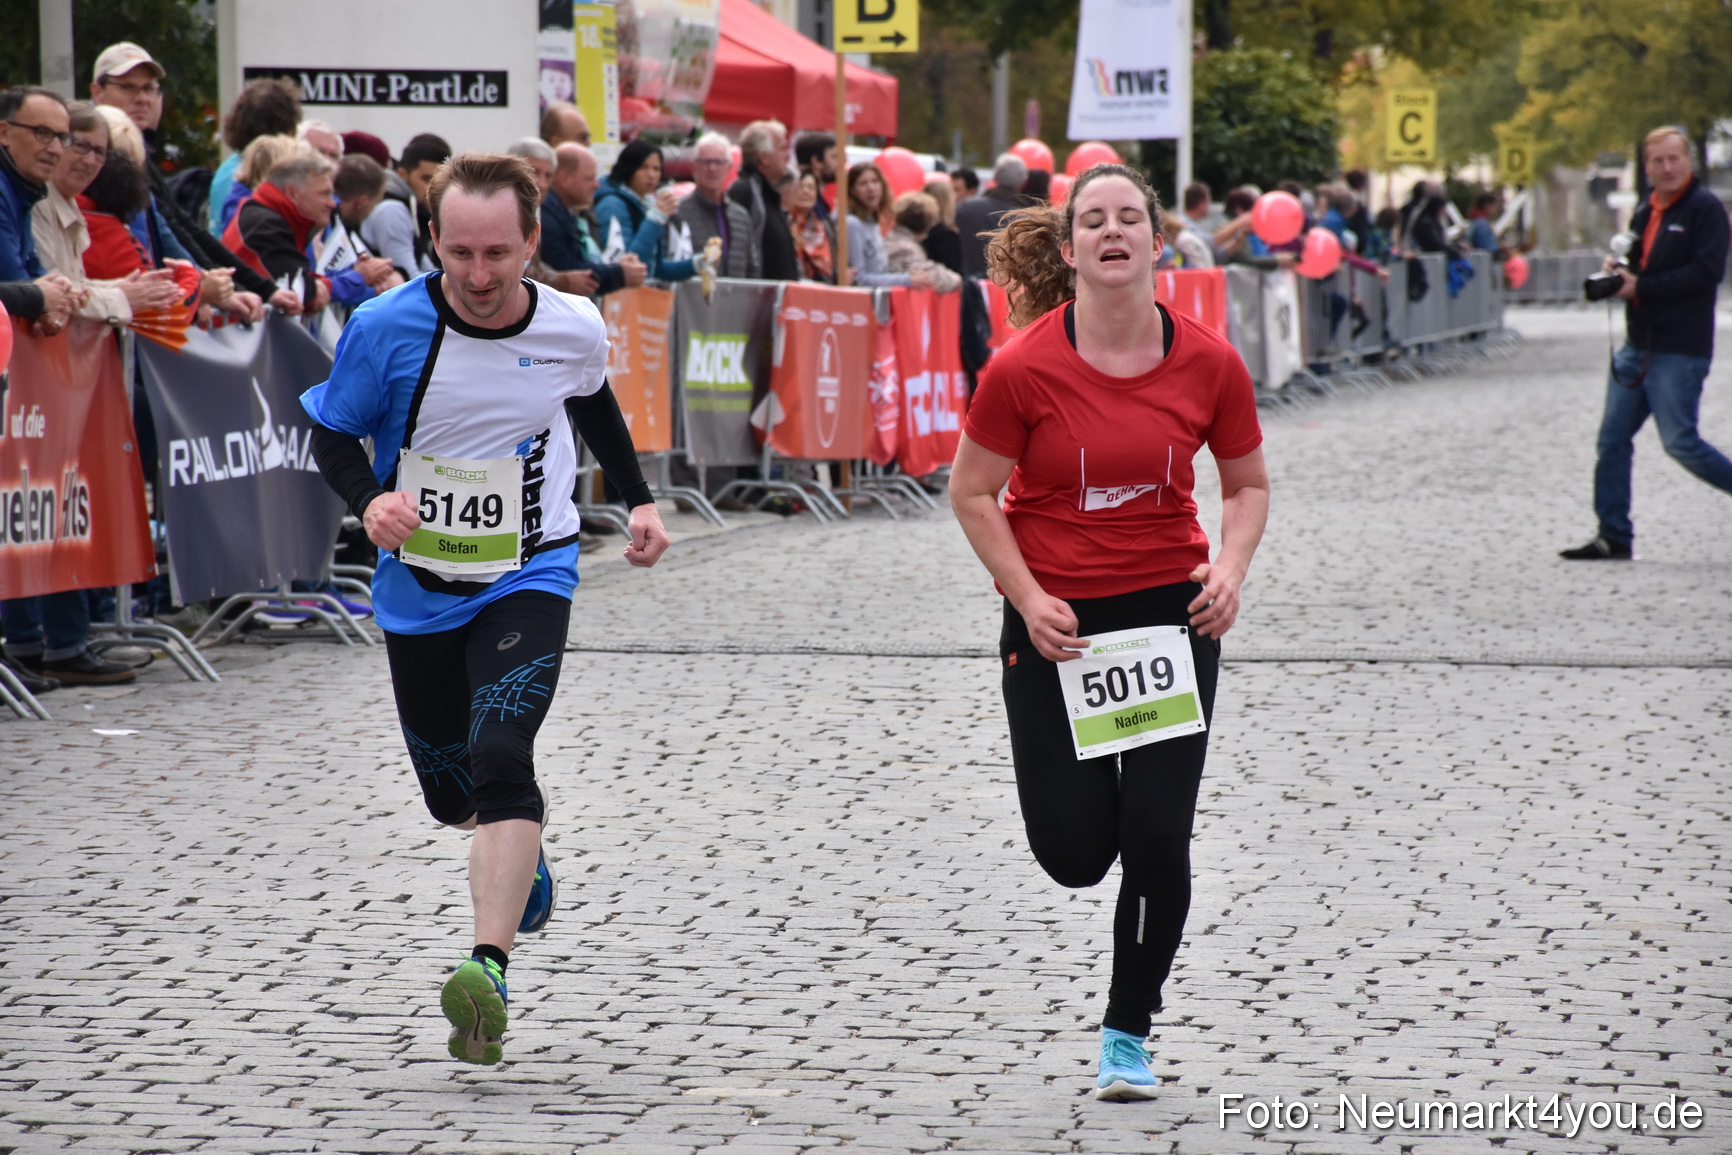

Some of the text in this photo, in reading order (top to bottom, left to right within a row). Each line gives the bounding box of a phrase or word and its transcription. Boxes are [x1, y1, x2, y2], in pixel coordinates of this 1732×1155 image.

[300, 73, 499, 103] MINI-Partl.de
[1399, 112, 1421, 144] C
[446, 467, 487, 480] BOCK
[1106, 485, 1135, 502] DEHN
[418, 487, 503, 529] 5149
[438, 539, 478, 554] Stefan
[1105, 638, 1150, 652] BOCK
[1081, 656, 1175, 708] 5019
[1114, 709, 1158, 730] Nadine
